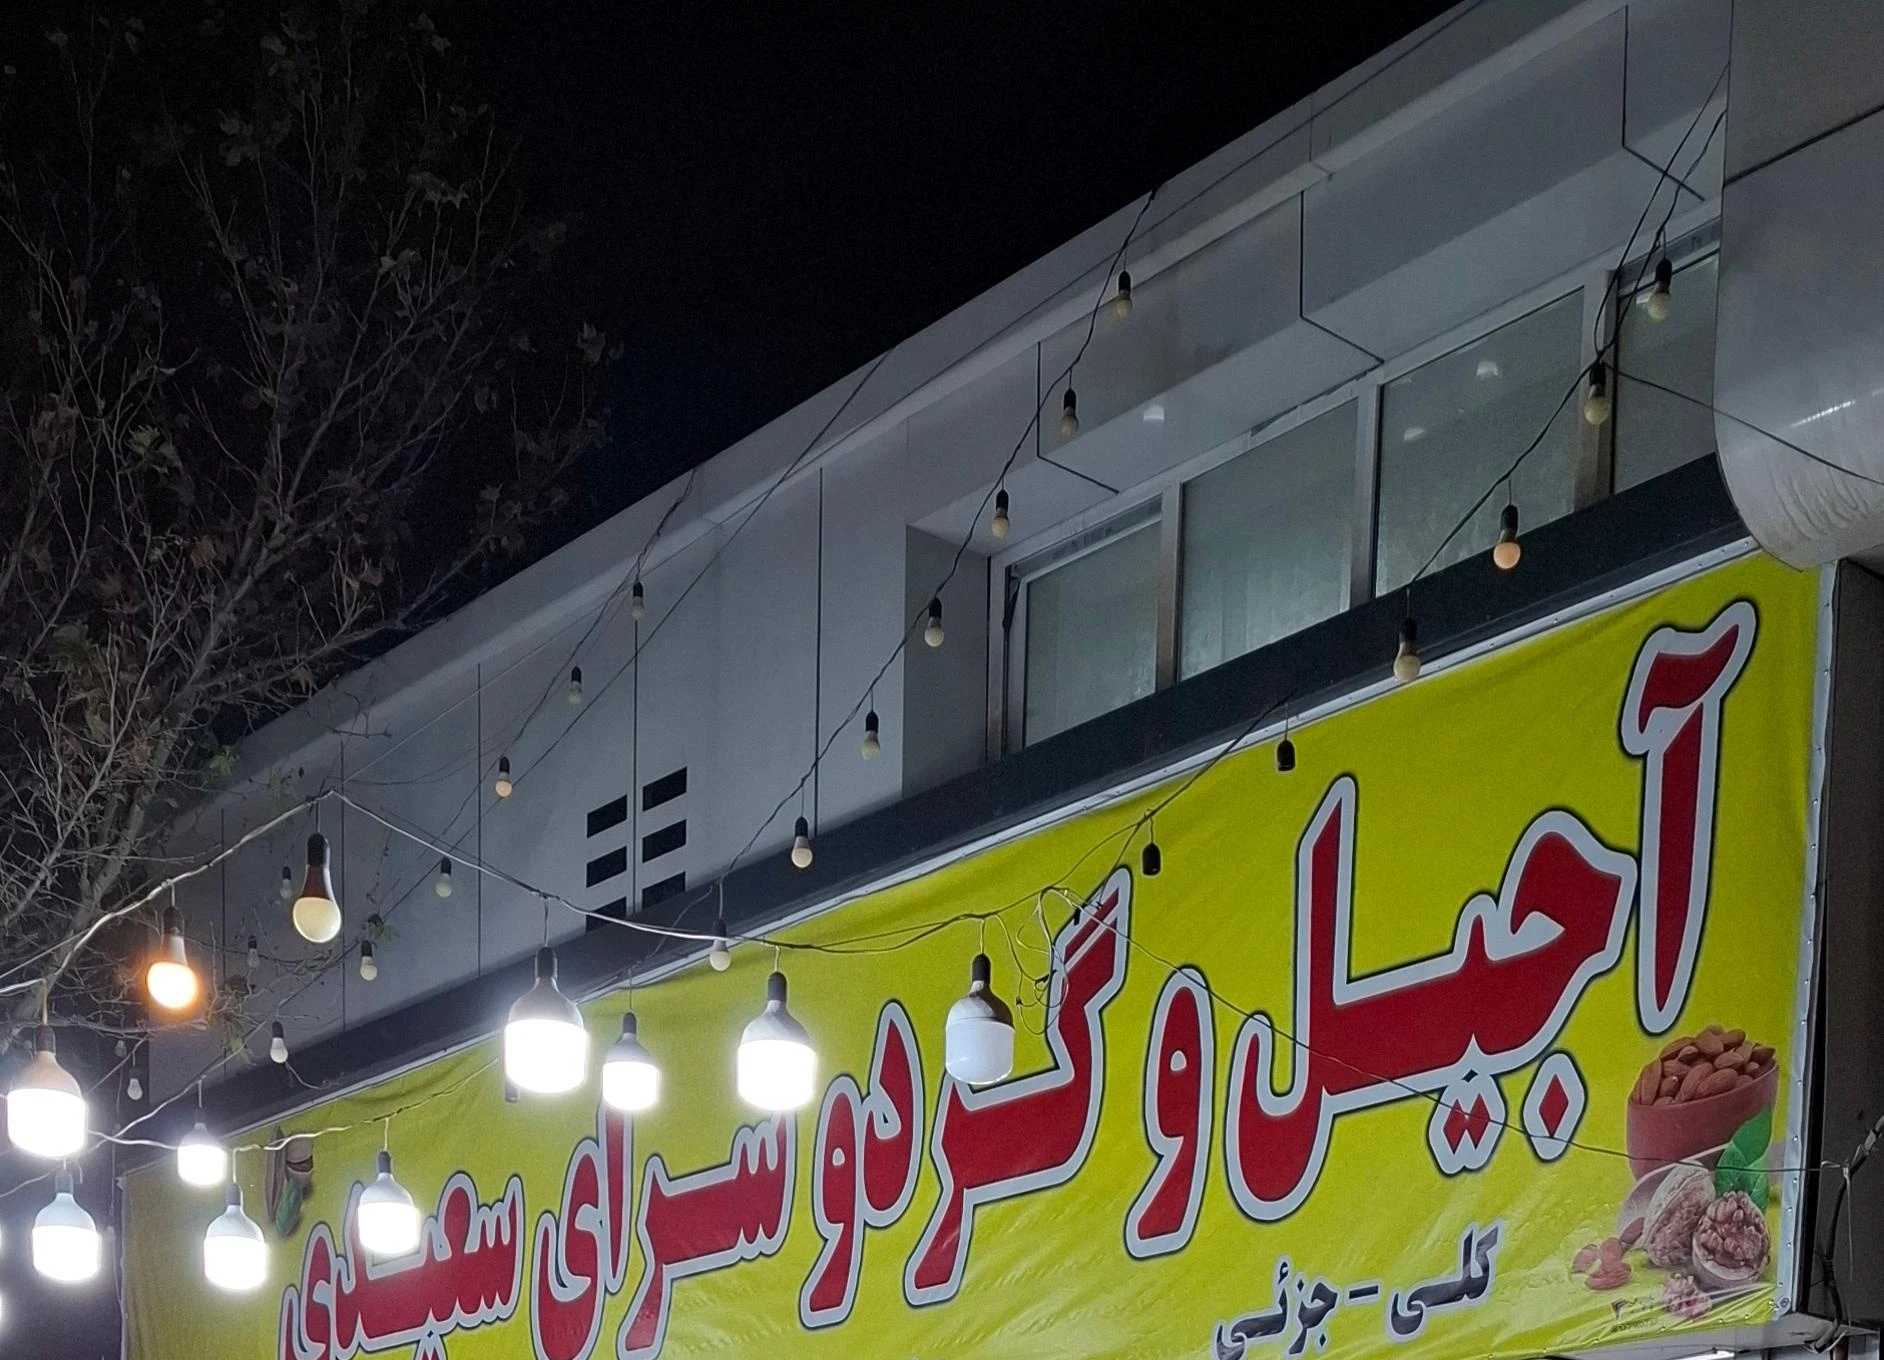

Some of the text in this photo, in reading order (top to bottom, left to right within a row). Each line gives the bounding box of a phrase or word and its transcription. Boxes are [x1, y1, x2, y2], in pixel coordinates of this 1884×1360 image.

[802, 868, 1129, 1326] گردو
[1228, 602, 1756, 1220] آجیل
[1126, 967, 1213, 1257] و
[1389, 1224, 1501, 1337] کلی
